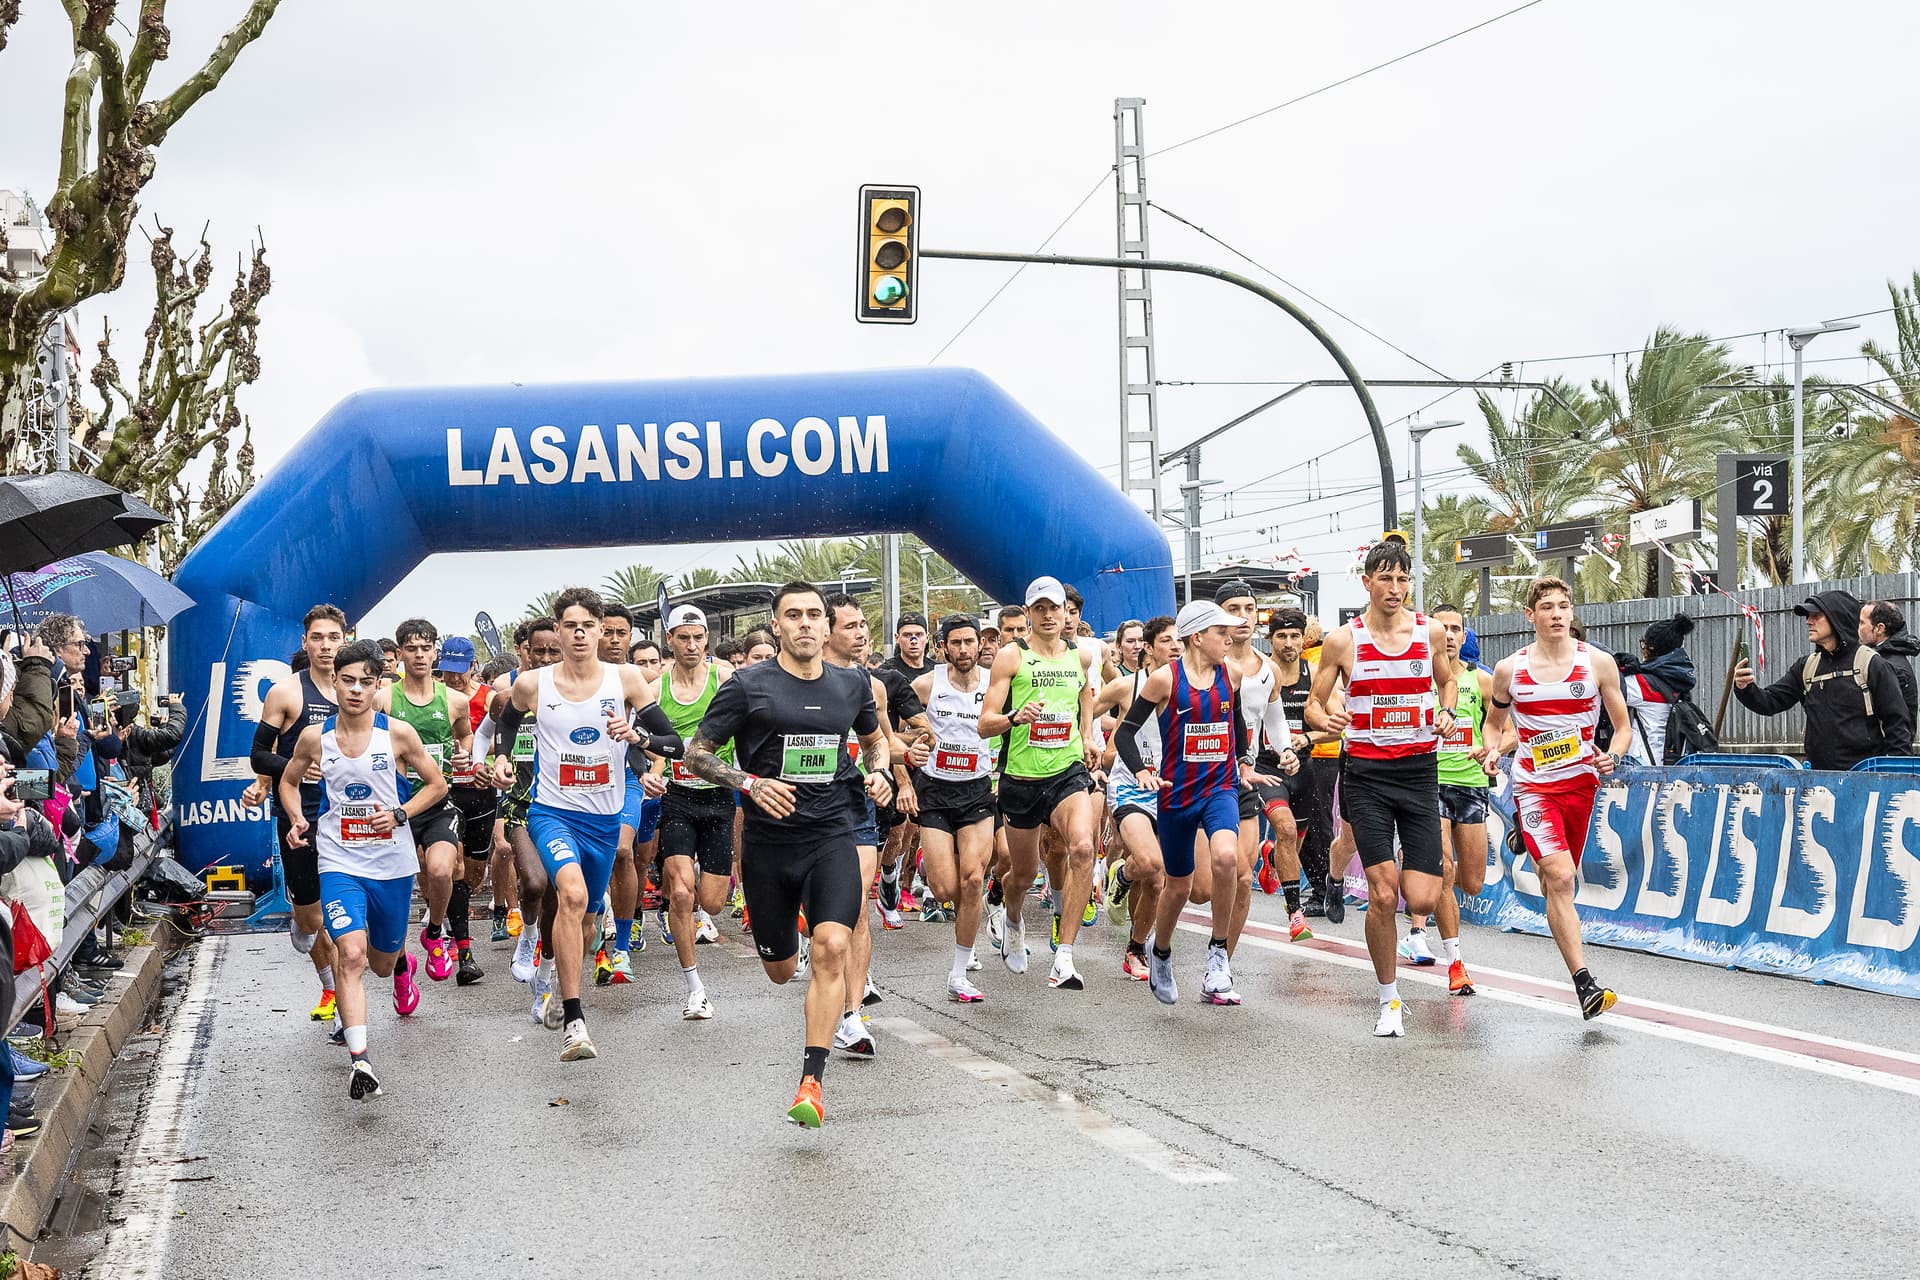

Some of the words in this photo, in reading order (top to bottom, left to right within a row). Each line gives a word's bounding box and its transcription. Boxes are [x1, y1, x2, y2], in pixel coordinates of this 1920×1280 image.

[446, 415, 889, 486] LASANSI.COM
[1753, 463, 1773, 477] via
[1752, 480, 1774, 510] 2
[1373, 696, 1398, 706] LASANSI
[1382, 711, 1411, 723] JORDI
[1187, 725, 1210, 734] LASANSI
[787, 736, 816, 747] LASANSI
[1197, 739, 1220, 750] HUGO
[1542, 743, 1571, 759] ROGER
[561, 753, 586, 765] LASANSI
[800, 754, 825, 768] FRAN
[946, 756, 970, 767] DAVID
[574, 769, 596, 781] IKER
[341, 807, 367, 817] LASANSI
